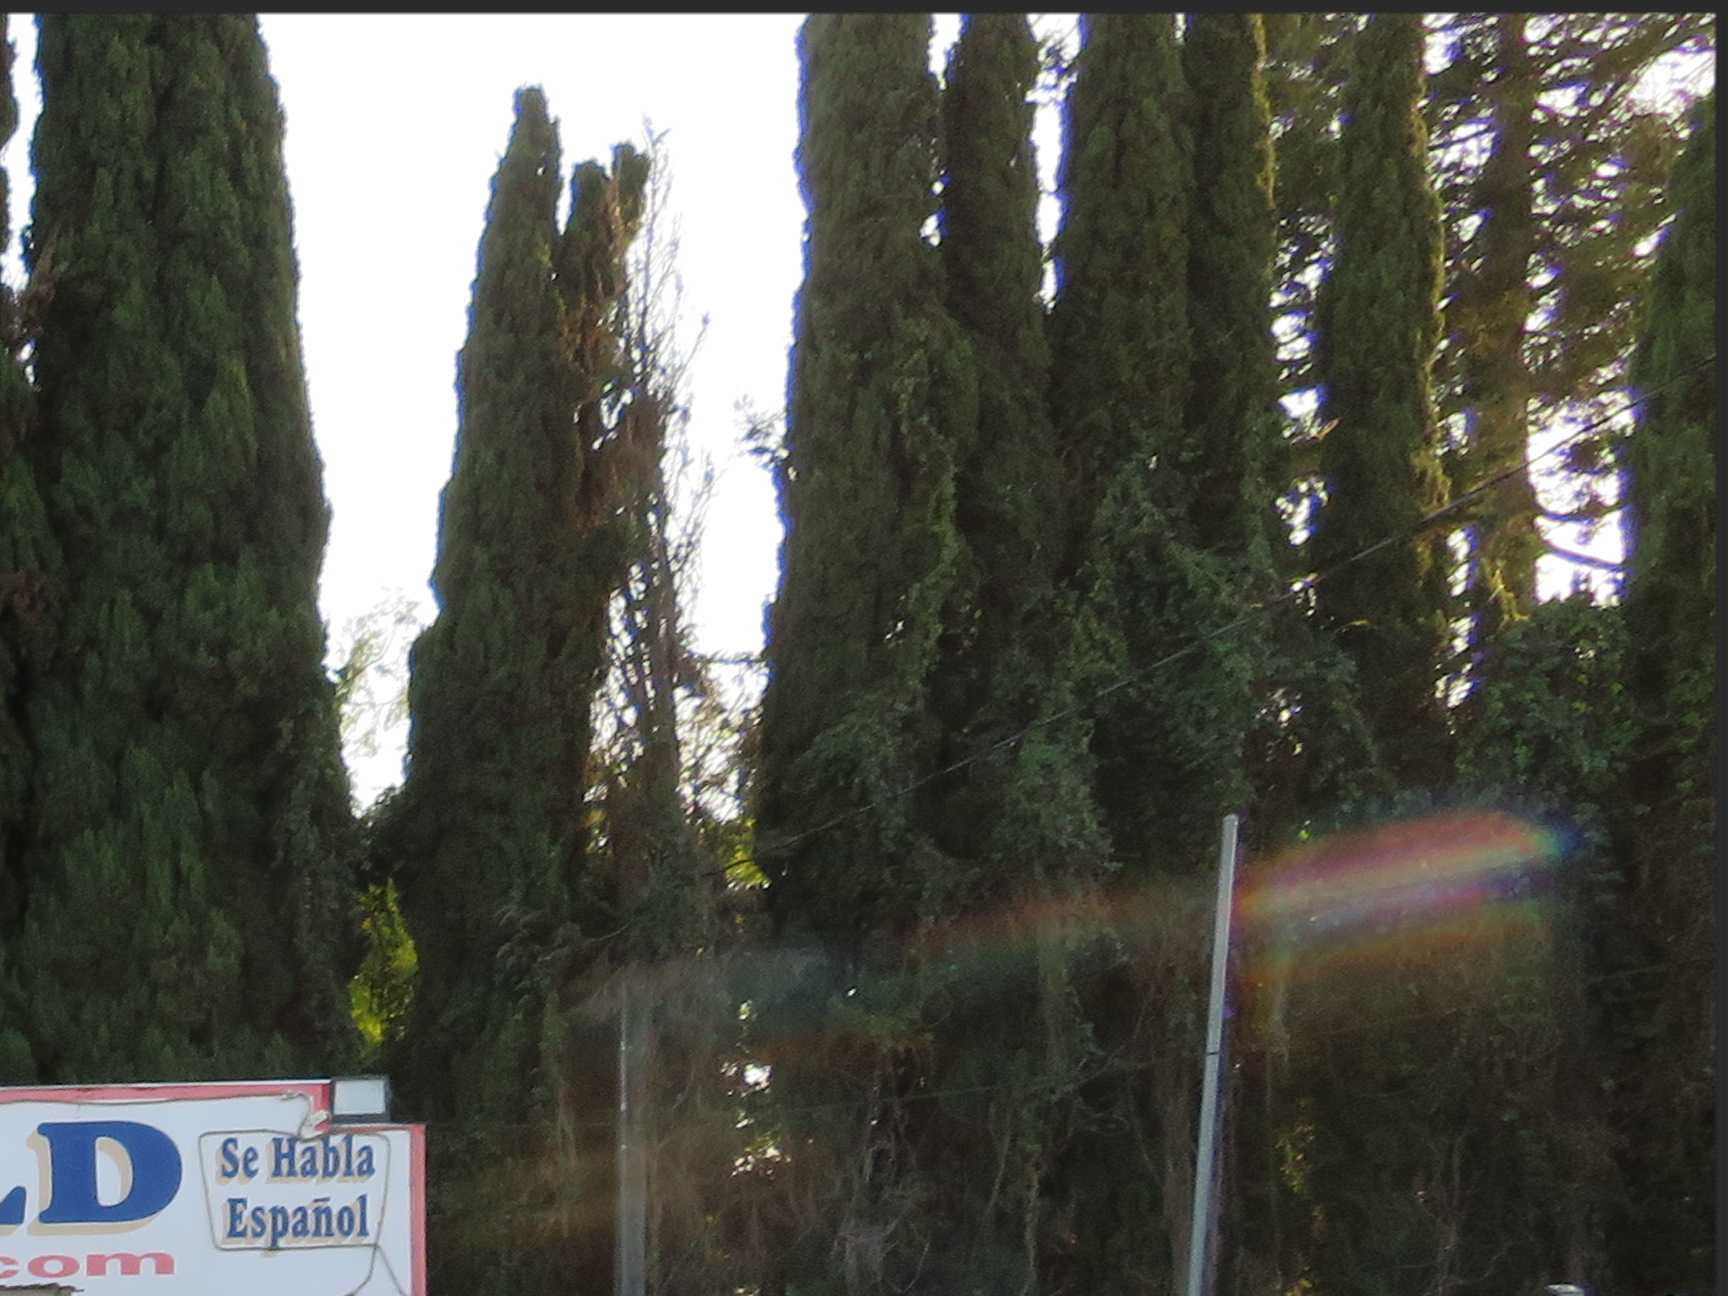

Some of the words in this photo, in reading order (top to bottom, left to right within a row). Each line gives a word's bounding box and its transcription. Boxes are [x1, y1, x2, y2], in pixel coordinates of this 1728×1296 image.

[219, 1136, 258, 1180] Se
[271, 1132, 376, 1181] Habla
[224, 1192, 370, 1246] Español
